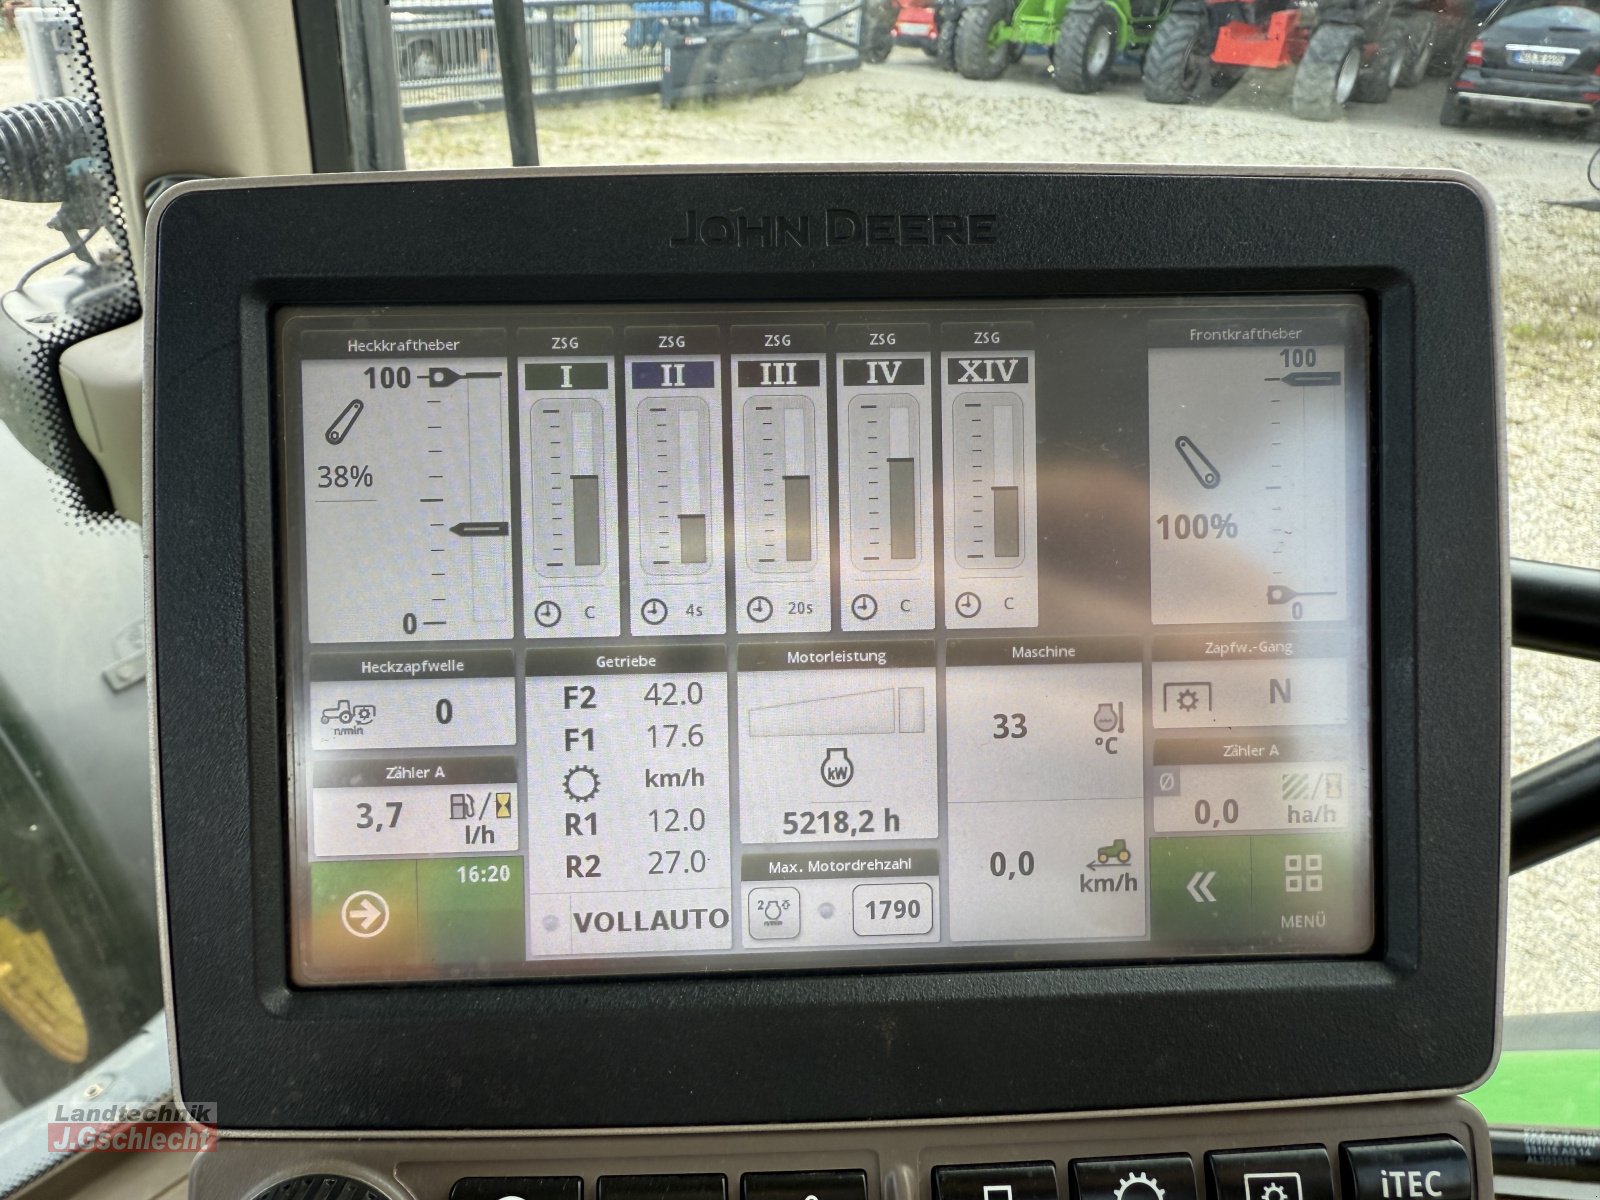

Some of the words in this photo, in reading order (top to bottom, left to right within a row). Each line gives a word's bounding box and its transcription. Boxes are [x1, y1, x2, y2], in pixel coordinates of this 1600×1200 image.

[824, 209, 998, 247] DEERE
[551, 337, 579, 349] ZSG
[658, 336, 686, 348] ZSG
[764, 334, 791, 347] ZSG
[869, 333, 896, 346] ZSG
[973, 331, 1000, 344] ZSG
[1189, 327, 1303, 342] Frontkraftheber
[347, 338, 461, 354] Heckkraftheber
[1279, 348, 1317, 368] 100
[363, 366, 411, 389] 100
[866, 361, 902, 384] IV
[957, 359, 1018, 383] XIV
[316, 464, 374, 488] 38%
[1155, 513, 1239, 541] 100%
[584, 605, 596, 619] C
[685, 603, 704, 617] 4s
[787, 601, 814, 615] 20s
[900, 599, 911, 612] C
[1004, 597, 1015, 610] C
[1291, 601, 1303, 620] 0
[402, 612, 417, 635] 0
[787, 650, 887, 665] Motorleistung
[1012, 645, 1076, 659] Maschine
[1205, 640, 1293, 657] Zapfw.-Gang
[361, 659, 465, 676] Heckzapfwelle
[596, 655, 657, 668] Getriebe
[563, 685, 597, 710] F2
[643, 681, 704, 706] 42.0
[1269, 678, 1292, 704] N
[435, 698, 454, 725] 0
[993, 713, 1028, 739] 33
[564, 727, 595, 752] F1
[647, 723, 704, 749] 17.6
[1223, 744, 1264, 757] Zähler
[1269, 744, 1280, 756] A
[386, 766, 430, 779] Zähler
[434, 766, 446, 778] A
[645, 767, 705, 788] km/h
[827, 766, 848, 780] kW
[356, 802, 403, 832] 3,7
[565, 812, 598, 836] R1
[649, 807, 706, 833] 12.0
[783, 809, 875, 837] 5218,2
[884, 808, 900, 832] h
[1194, 799, 1239, 828] 0,0
[1287, 804, 1336, 824] ha/h
[465, 825, 495, 845] l/h
[457, 865, 511, 883] 16:20
[566, 854, 602, 879] R2
[648, 850, 707, 875] 27.0
[769, 861, 803, 874] Max.
[808, 858, 912, 873] Motordrehzahl
[990, 850, 1035, 881] 0,0
[1080, 873, 1138, 893] km/h
[865, 900, 921, 920] 1790
[1281, 911, 1326, 928] MENÜ
[573, 908, 730, 933] VOLLAUTO
[1381, 1170, 1443, 1198] iTEC
